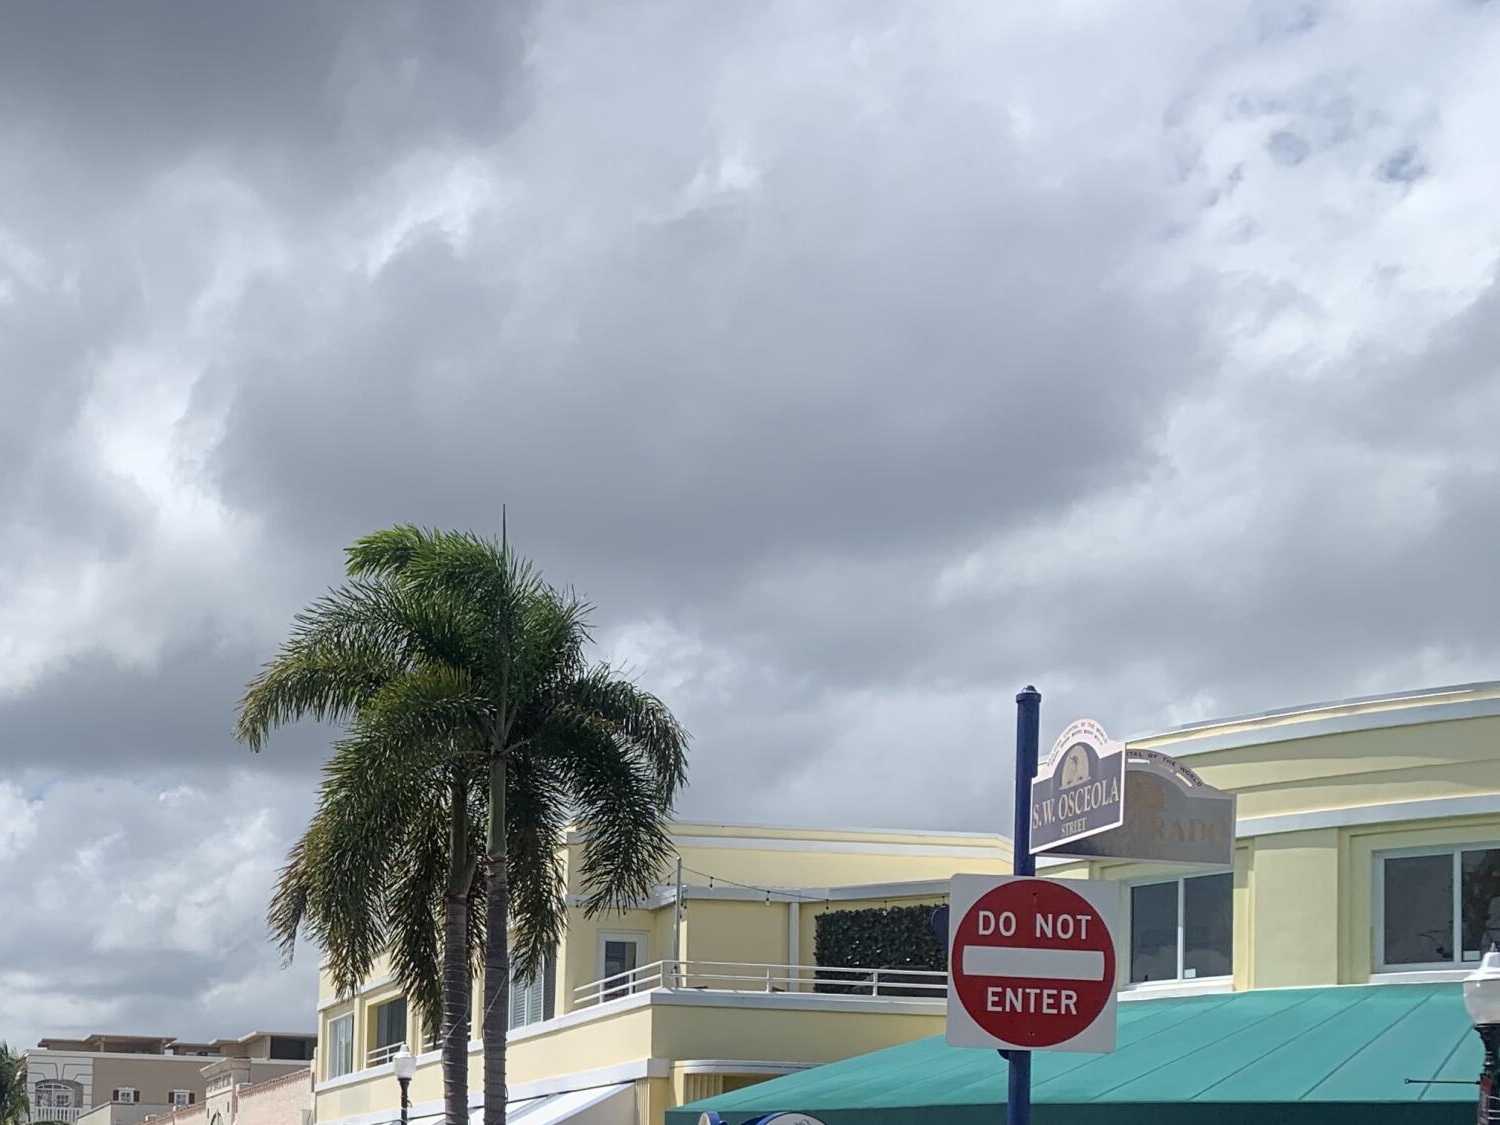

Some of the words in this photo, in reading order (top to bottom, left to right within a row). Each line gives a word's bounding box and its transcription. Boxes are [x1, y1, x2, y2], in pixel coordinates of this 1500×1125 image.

[1163, 757, 1176, 766] THE
[1180, 767, 1202, 787] WORLD
[1058, 776, 1120, 819] OSCEOLA
[1060, 817, 1087, 837] STREET
[978, 910, 1017, 937] DO
[1035, 913, 1092, 940] NOT
[986, 986, 1078, 1015] ENTER
